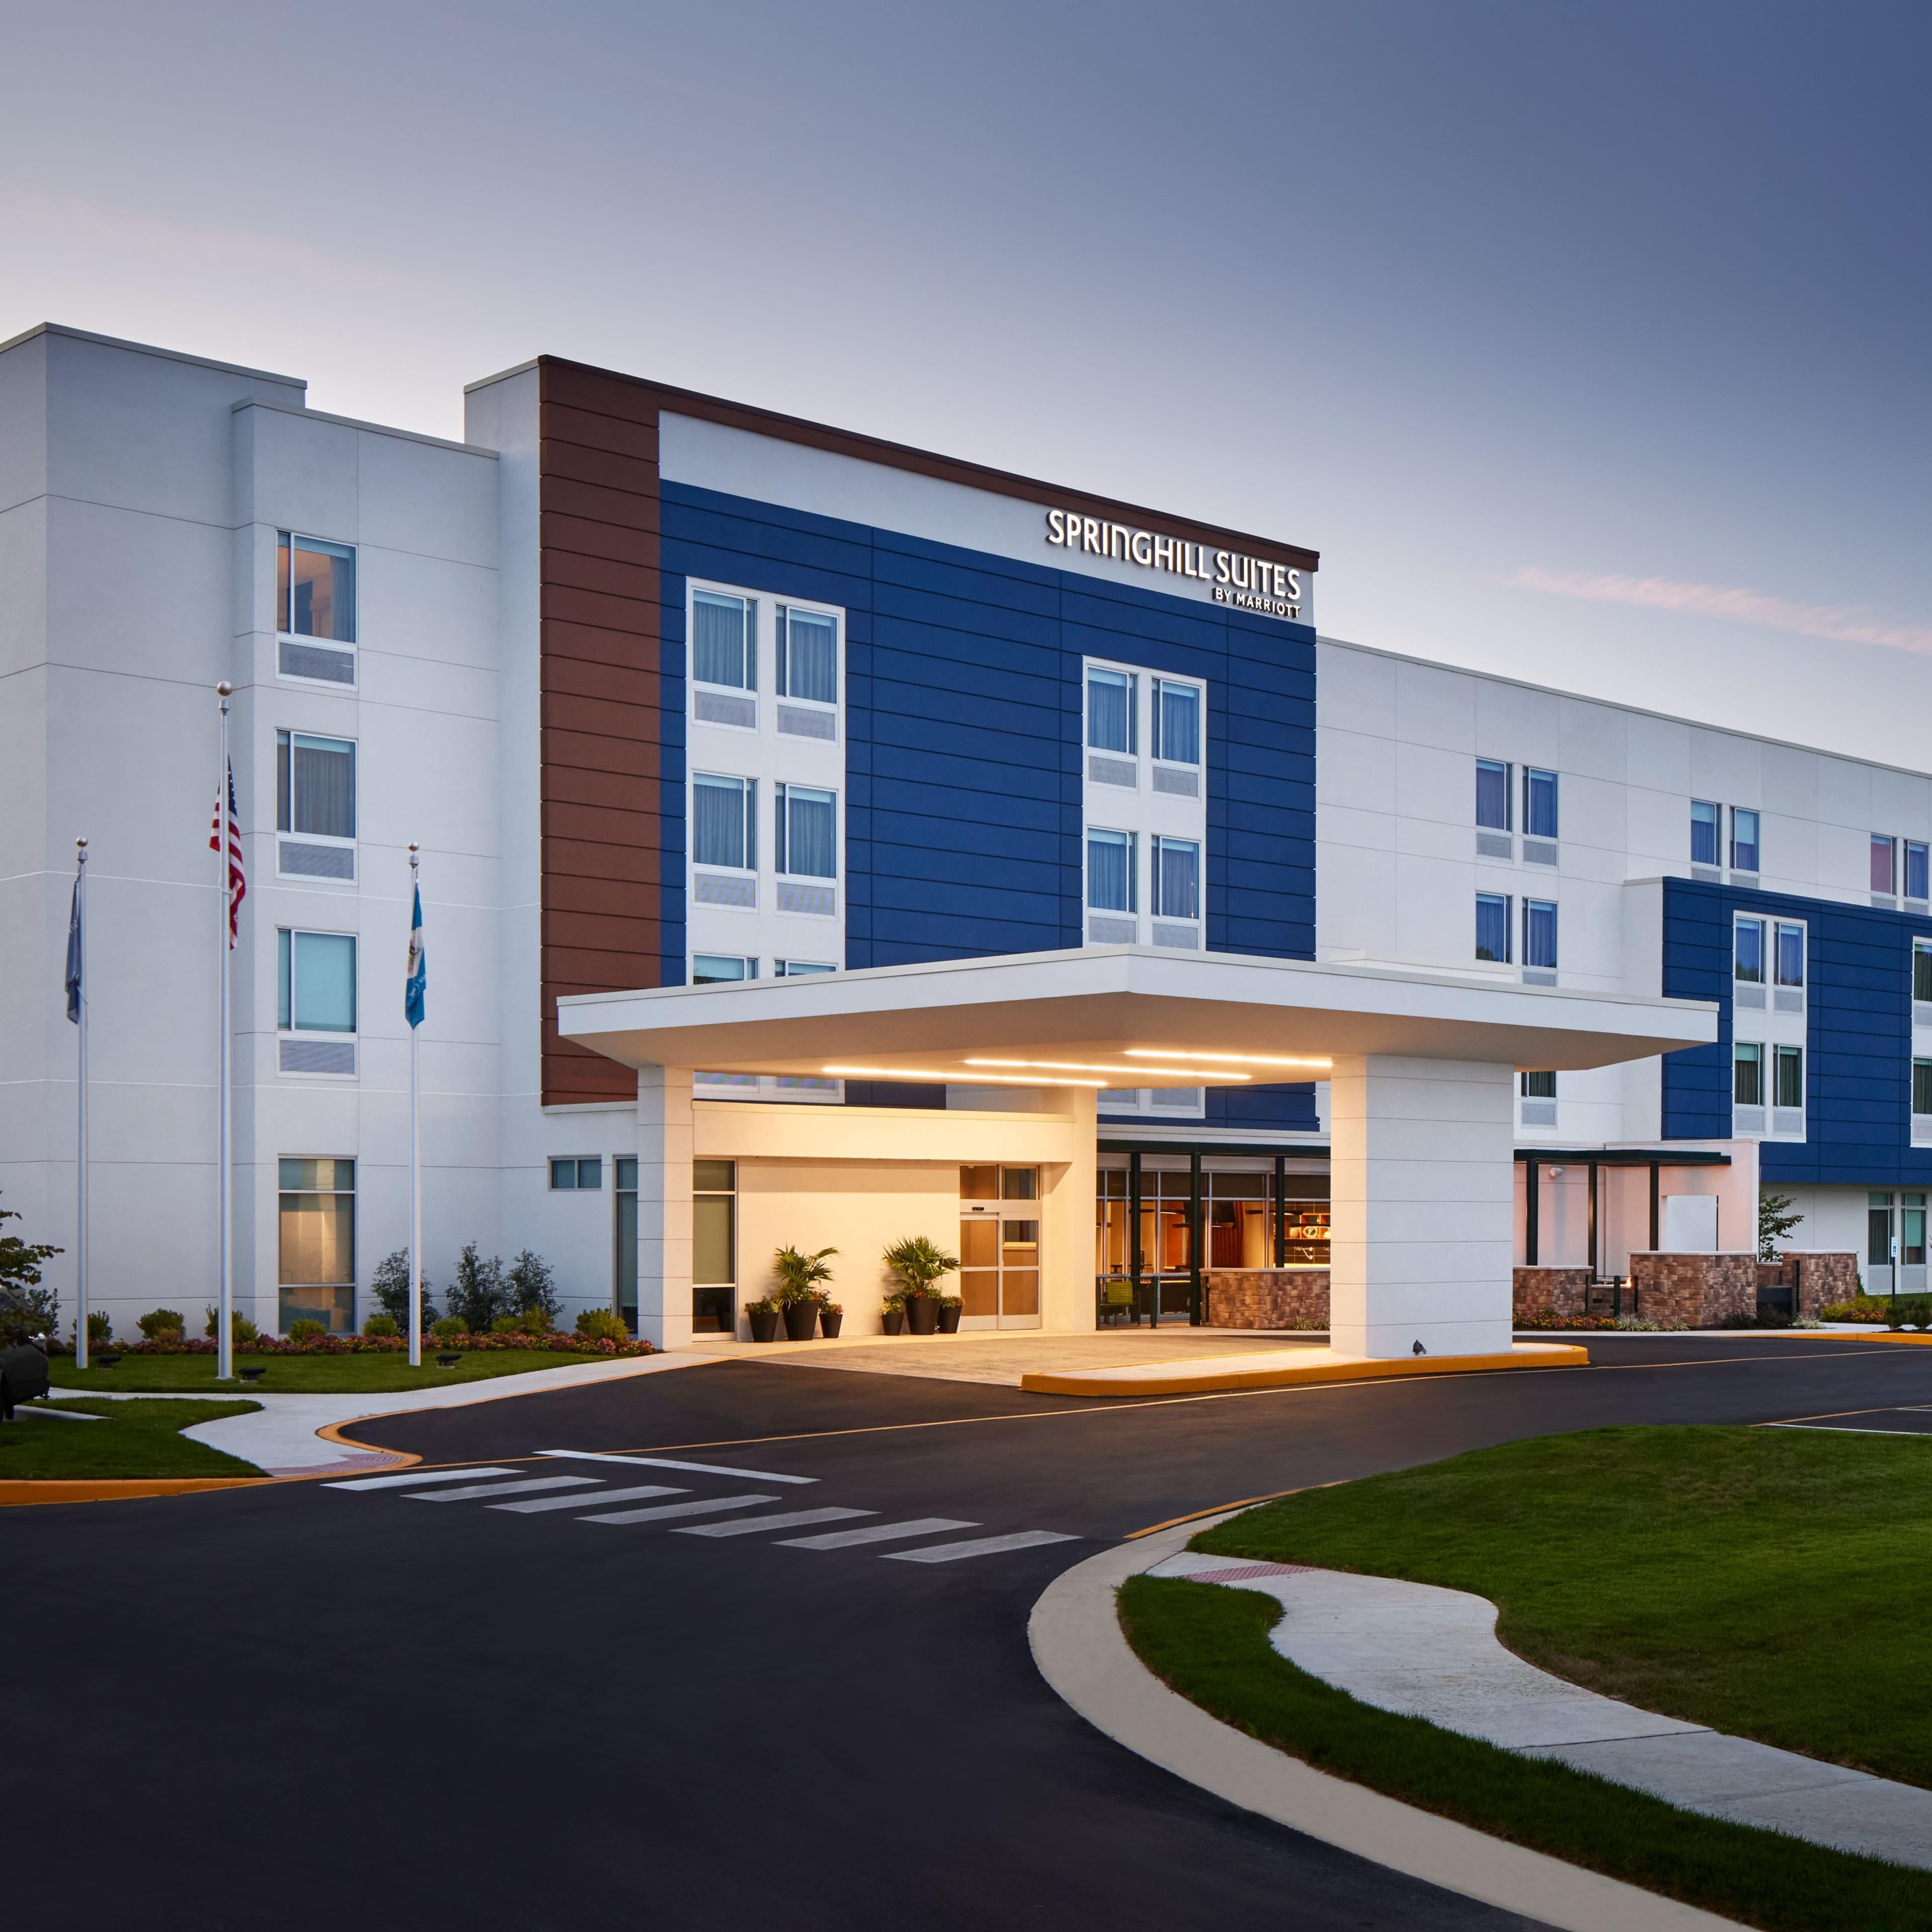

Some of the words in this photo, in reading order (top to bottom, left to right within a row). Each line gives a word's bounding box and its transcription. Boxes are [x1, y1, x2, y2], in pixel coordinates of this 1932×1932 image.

[1046, 510, 1211, 580] SPRINGHILL
[1214, 551, 1301, 600] SUITES
[1213, 587, 1231, 602] BY
[1234, 592, 1301, 618] MARRIOTT
